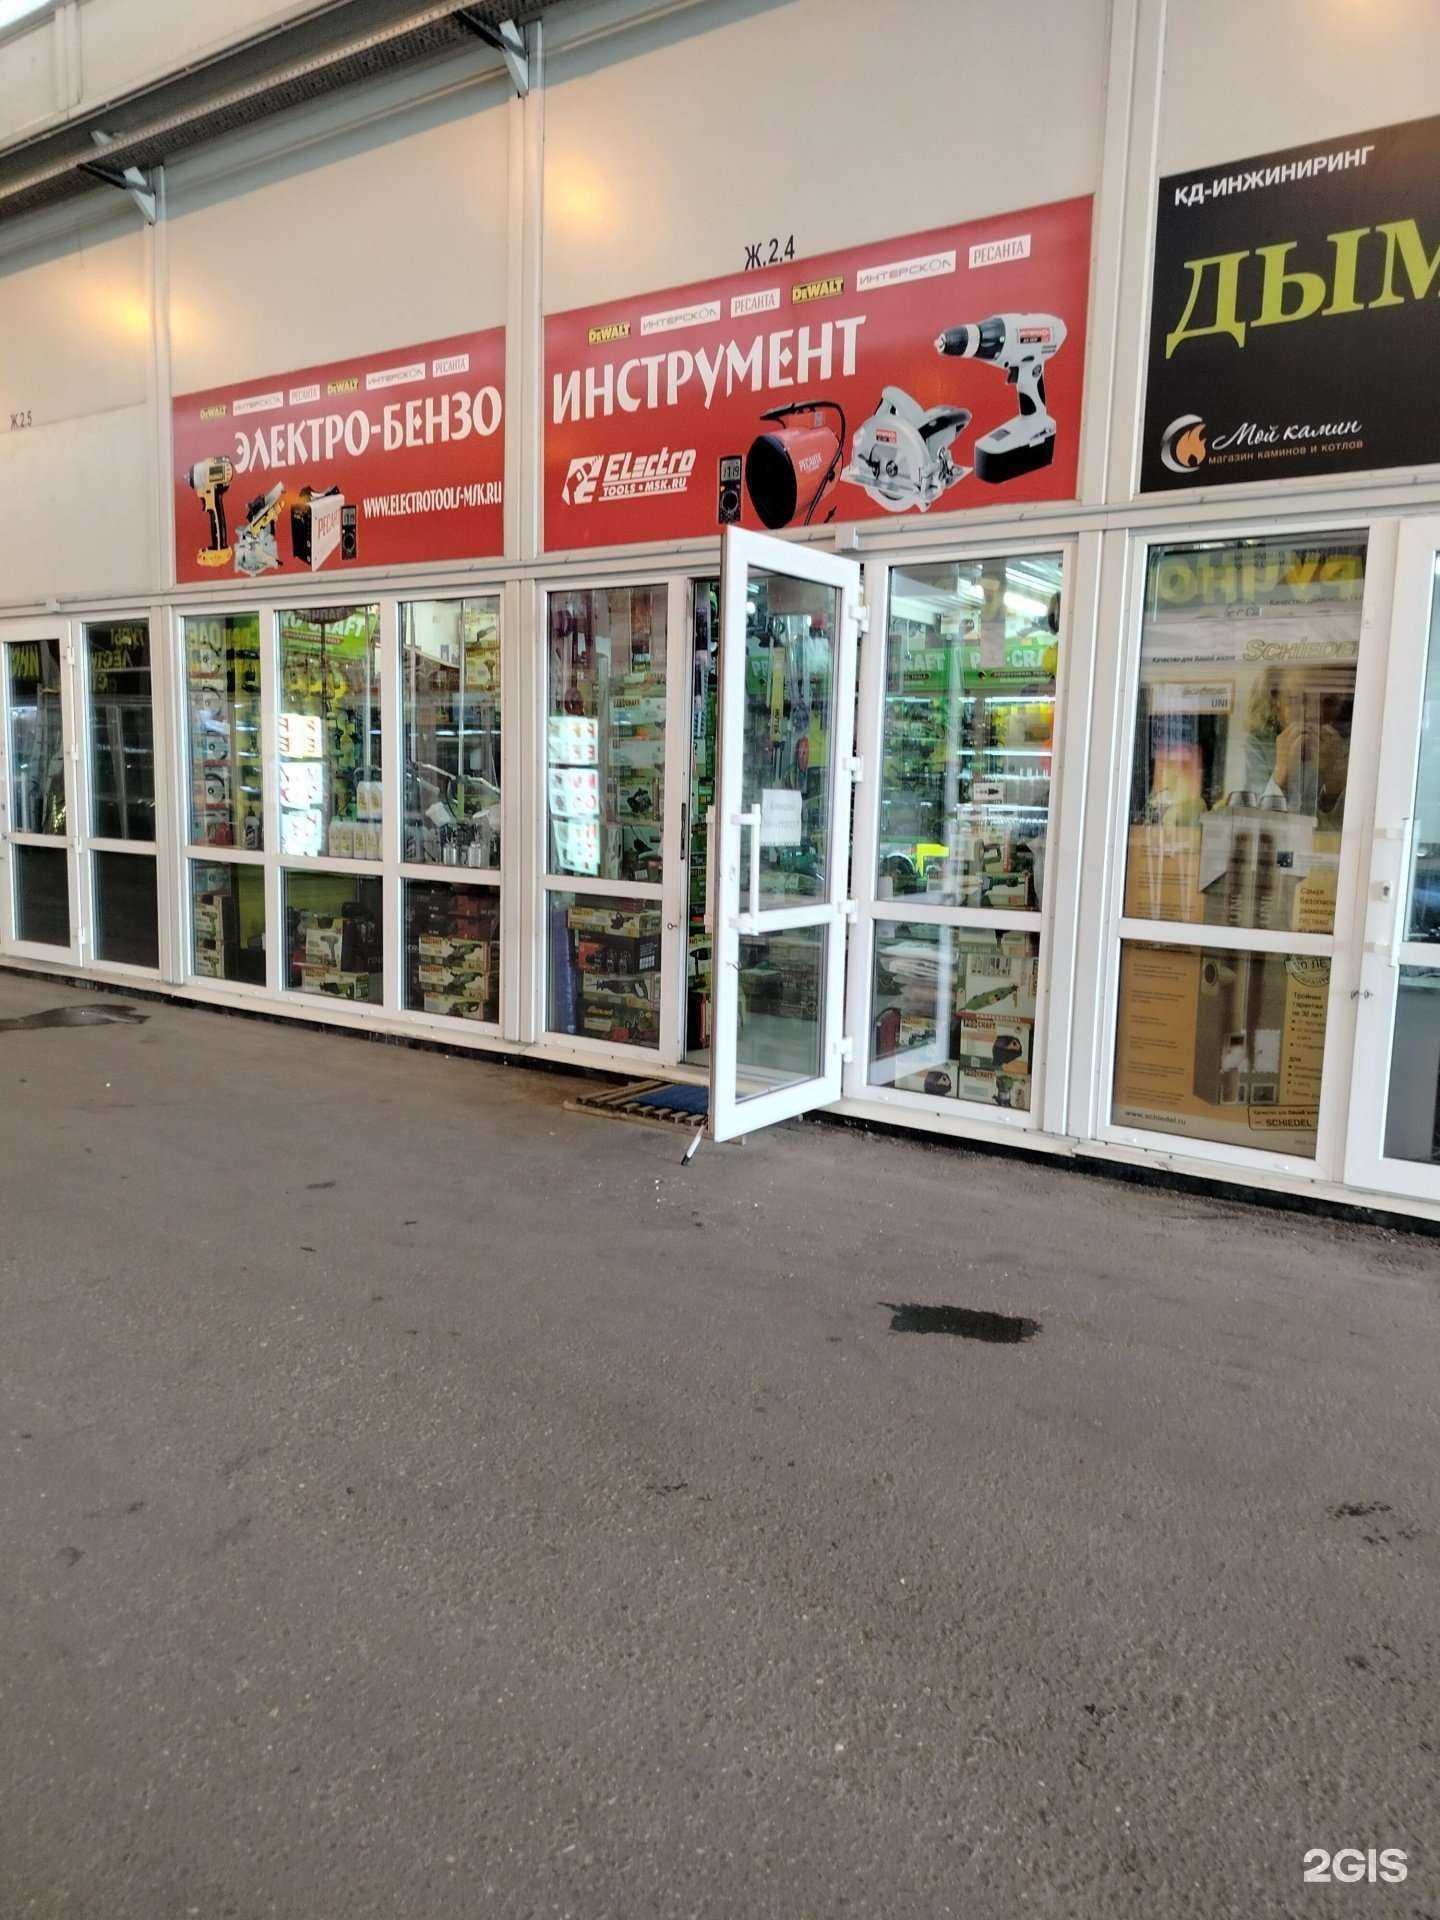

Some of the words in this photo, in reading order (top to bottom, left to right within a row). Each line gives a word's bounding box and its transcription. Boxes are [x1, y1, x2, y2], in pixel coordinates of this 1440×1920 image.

[1174, 145, 1375, 207] КД-ИНЖИНИРИНГ
[745, 234, 795, 272] Ж.2.4
[643, 308, 717, 331] ИНТЕРСКОЛ
[734, 294, 776, 314] РЕСАНТА
[860, 259, 951, 285] ИНТЕРСКОЛ
[974, 241, 1025, 265] РЕСАНТА
[435, 357, 466, 375] РЕСАНТА
[553, 314, 867, 425] ИНСТРУМЕНТ
[233, 386, 502, 475] ЭЛЕКТРО-БЕНЗО
[1212, 422, 1279, 450] Мой
[1283, 420, 1361, 440] камин
[1208, 453, 1254, 465] магазин
[1257, 447, 1306, 459] каминов
[1310, 446, 1317, 454] и
[1321, 440, 1363, 453] котлов
[363, 481, 503, 519] WWW.ELECTROTOOLS-MSK.RU
